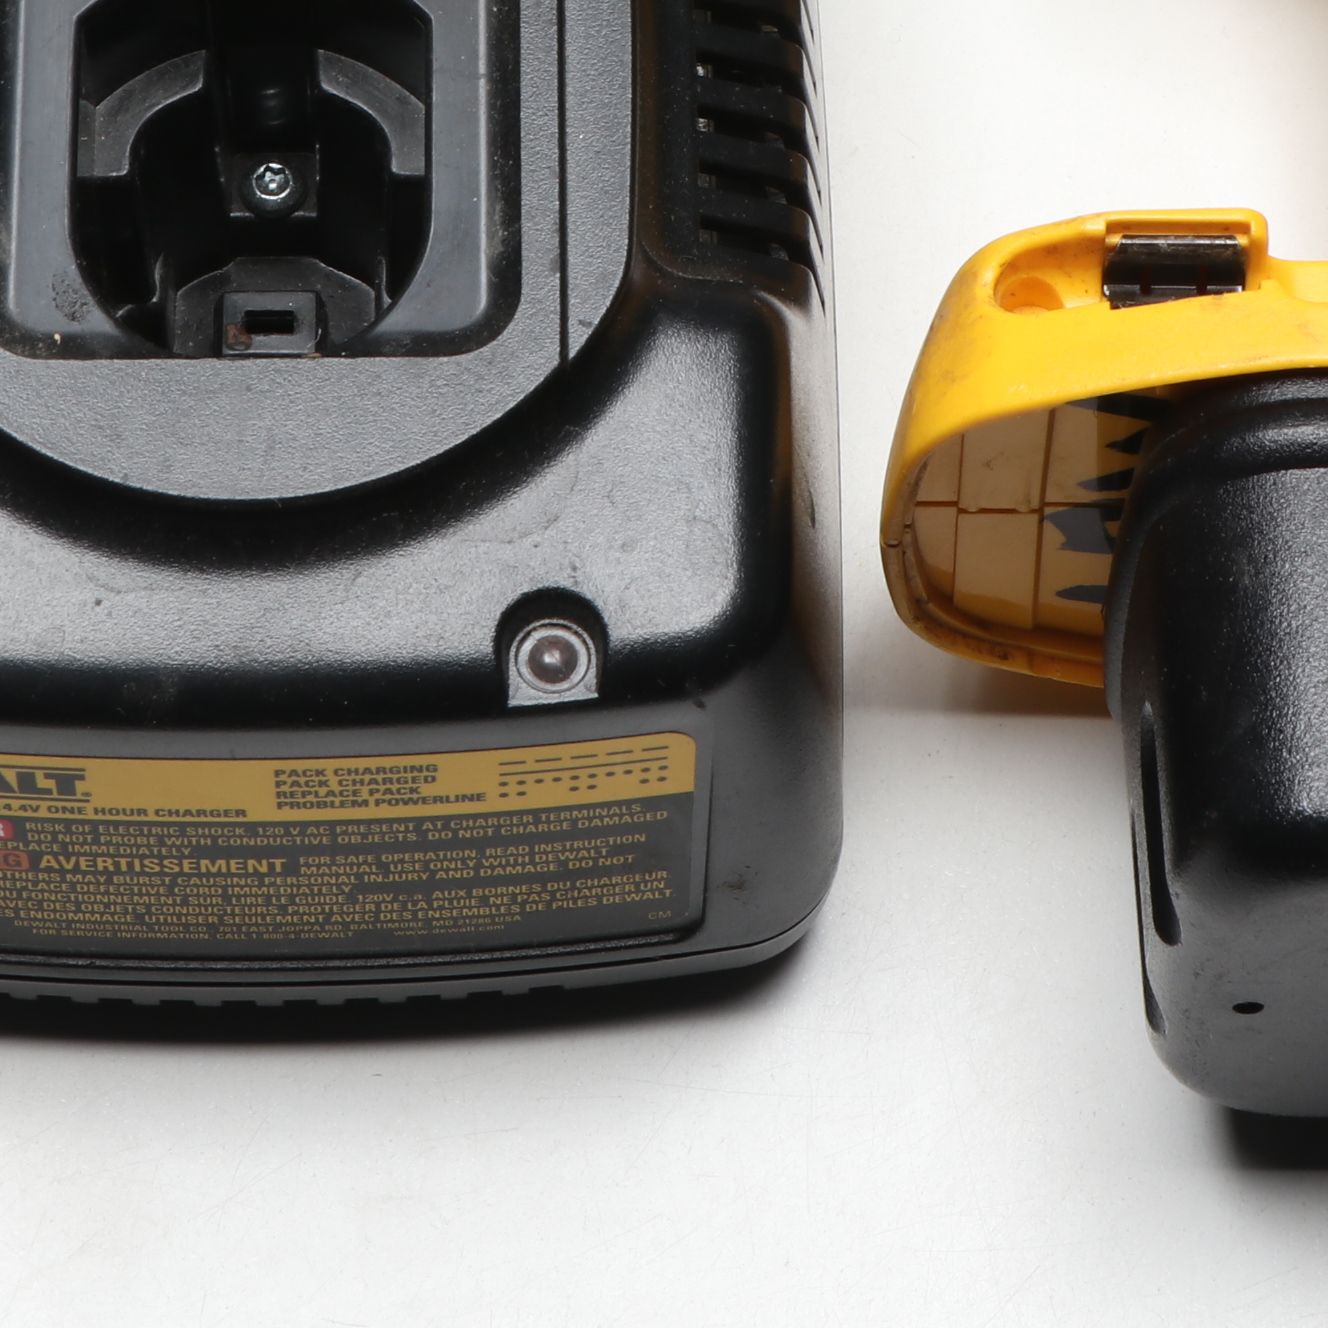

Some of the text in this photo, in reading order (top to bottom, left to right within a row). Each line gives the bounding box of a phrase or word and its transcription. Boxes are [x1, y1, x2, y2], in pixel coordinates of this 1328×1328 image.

[274, 764, 438, 778] PACK CHARGING
[275, 775, 436, 789] PACK CHARGED
[276, 786, 421, 800] REPLACE PACK
[277, 792, 487, 810] PROBLEM POWERLINE
[48, 806, 87, 815] ONE
[94, 807, 147, 817] HOUR
[155, 809, 247, 818] CHARGER
[26, 823, 65, 832] RISK
[72, 824, 92, 833] OF
[99, 825, 180, 835] ELECTRIC
[258, 827, 284, 835] 120
[289, 826, 300, 835] V
[306, 826, 330, 834] AC
[336, 823, 417, 834] PRESENT
[422, 821, 444, 830] AT
[450, 815, 539, 829] CHARGER
[28, 833, 52, 842] DO
[58, 834, 94, 842] NOT
[101, 835, 158, 844] PROBE
[164, 837, 211, 846] WITH
[218, 836, 332, 846] CONDUCTIVE
[428, 831, 452, 840] DO
[459, 827, 499, 839] NOT
[501, 821, 573, 836] CHARGE
[578, 811, 668, 828] DAMAGED
[300, 856, 331, 865] FOR
[336, 855, 377, 864] SAFE
[486, 845, 529, 856] READ
[535, 834, 646, 852] INSTRUCTION
[39, 855, 287, 873] AVERTISSEMENT
[390, 863, 424, 872] USE
[430, 860, 477, 870] ONLY
[482, 856, 529, 867] WITH
[536, 848, 610, 863] DEWALT
[67, 874, 107, 883] MAY
[113, 876, 172, 885] BURST
[177, 877, 259, 885] CAUSING
[264, 875, 359, 885] PERSONAL
[364, 872, 429, 883] INJURY
[436, 870, 474, 879] AND
[569, 861, 592, 869] DO
[599, 855, 636, 866] NOT
[22, 892, 182, 904] FONCTIONNEMENT
[232, 897, 266, 905] LIRE
[272, 896, 288, 905] LE
[357, 894, 394, 902] 120V
[432, 889, 467, 899] AUX
[473, 884, 541, 897] BORNES
[547, 881, 570, 891] DU
[43, 901, 76, 911] DES
[81, 903, 146, 913] OBJETS
[288, 904, 376, 914] PROTEGER
[381, 902, 402, 911] DE
[408, 901, 428, 910] LA
[489, 895, 512, 905] NE
[517, 892, 550, 902] PAS
[556, 885, 635, 900] CHARGER
[640, 881, 665, 889] UN
[77, 883, 168, 895] DEFECTIVE
[175, 886, 222, 895] CORD
[145, 914, 218, 924] UTILISER
[223, 914, 327, 924] SEULEMENT
[331, 913, 374, 923] AVEC
[380, 911, 412, 920] DES
[418, 904, 521, 919] ENSEMBLES
[526, 903, 547, 912] DE
[553, 898, 598, 909] PILES
[496, 914, 521, 923] USA
[62, 929, 113, 938] SERVICE
